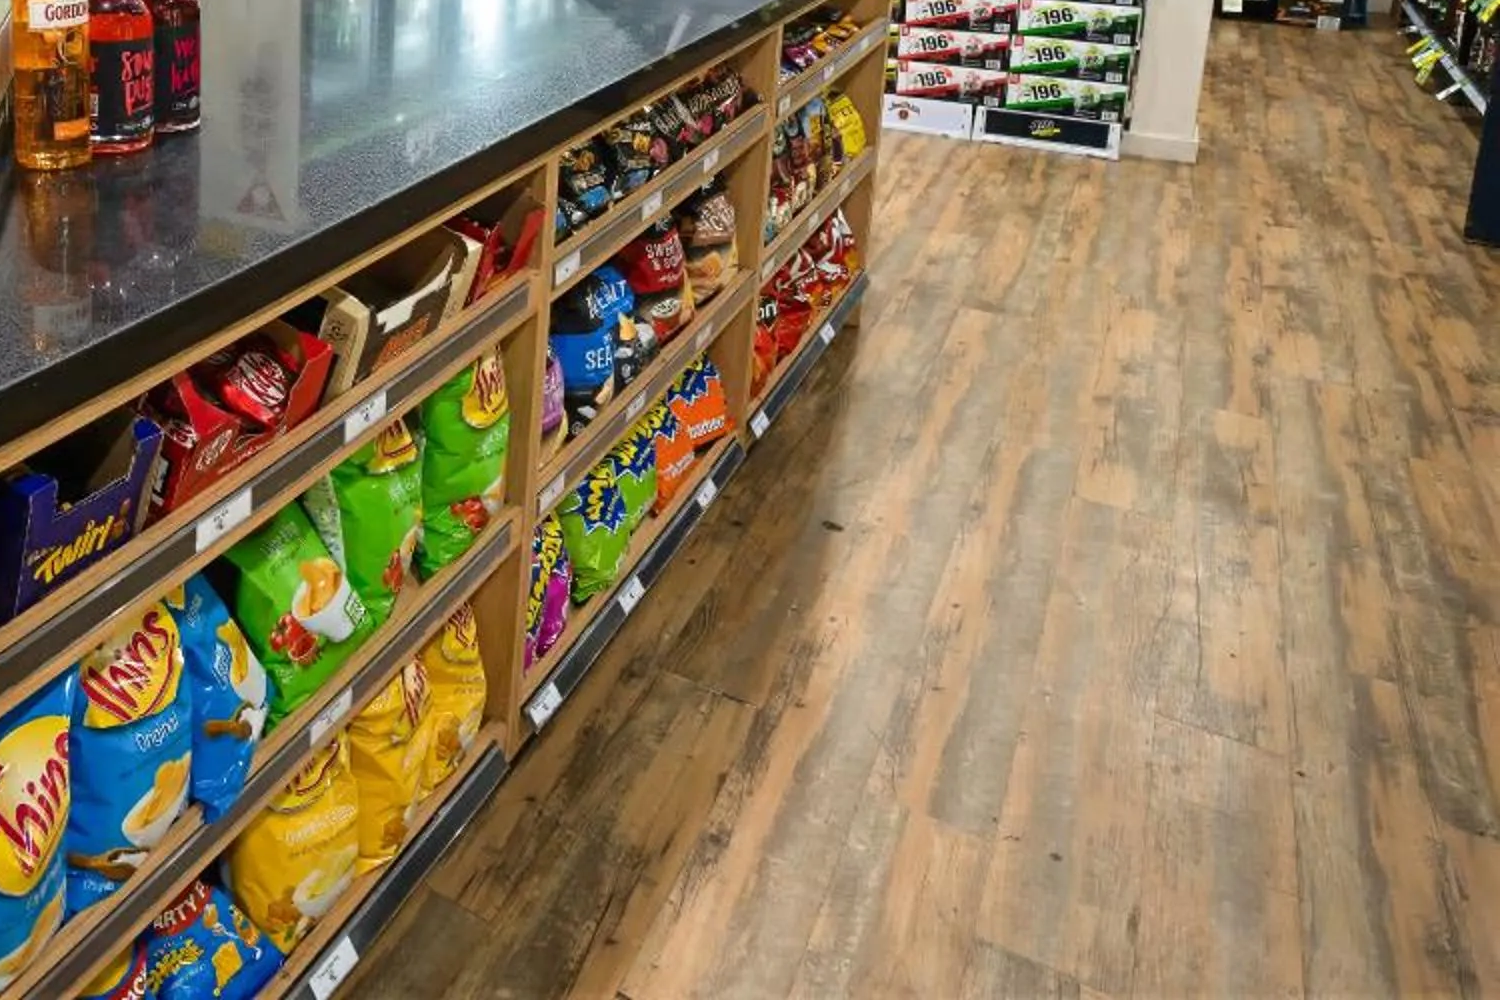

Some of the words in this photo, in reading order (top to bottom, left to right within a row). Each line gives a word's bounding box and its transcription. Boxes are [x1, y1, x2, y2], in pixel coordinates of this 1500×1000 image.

[1028, 46, 1066, 62] -196
[1023, 84, 1061, 100] -196
[35, 516, 115, 583] Twirl
[135, 712, 180, 753] Original
